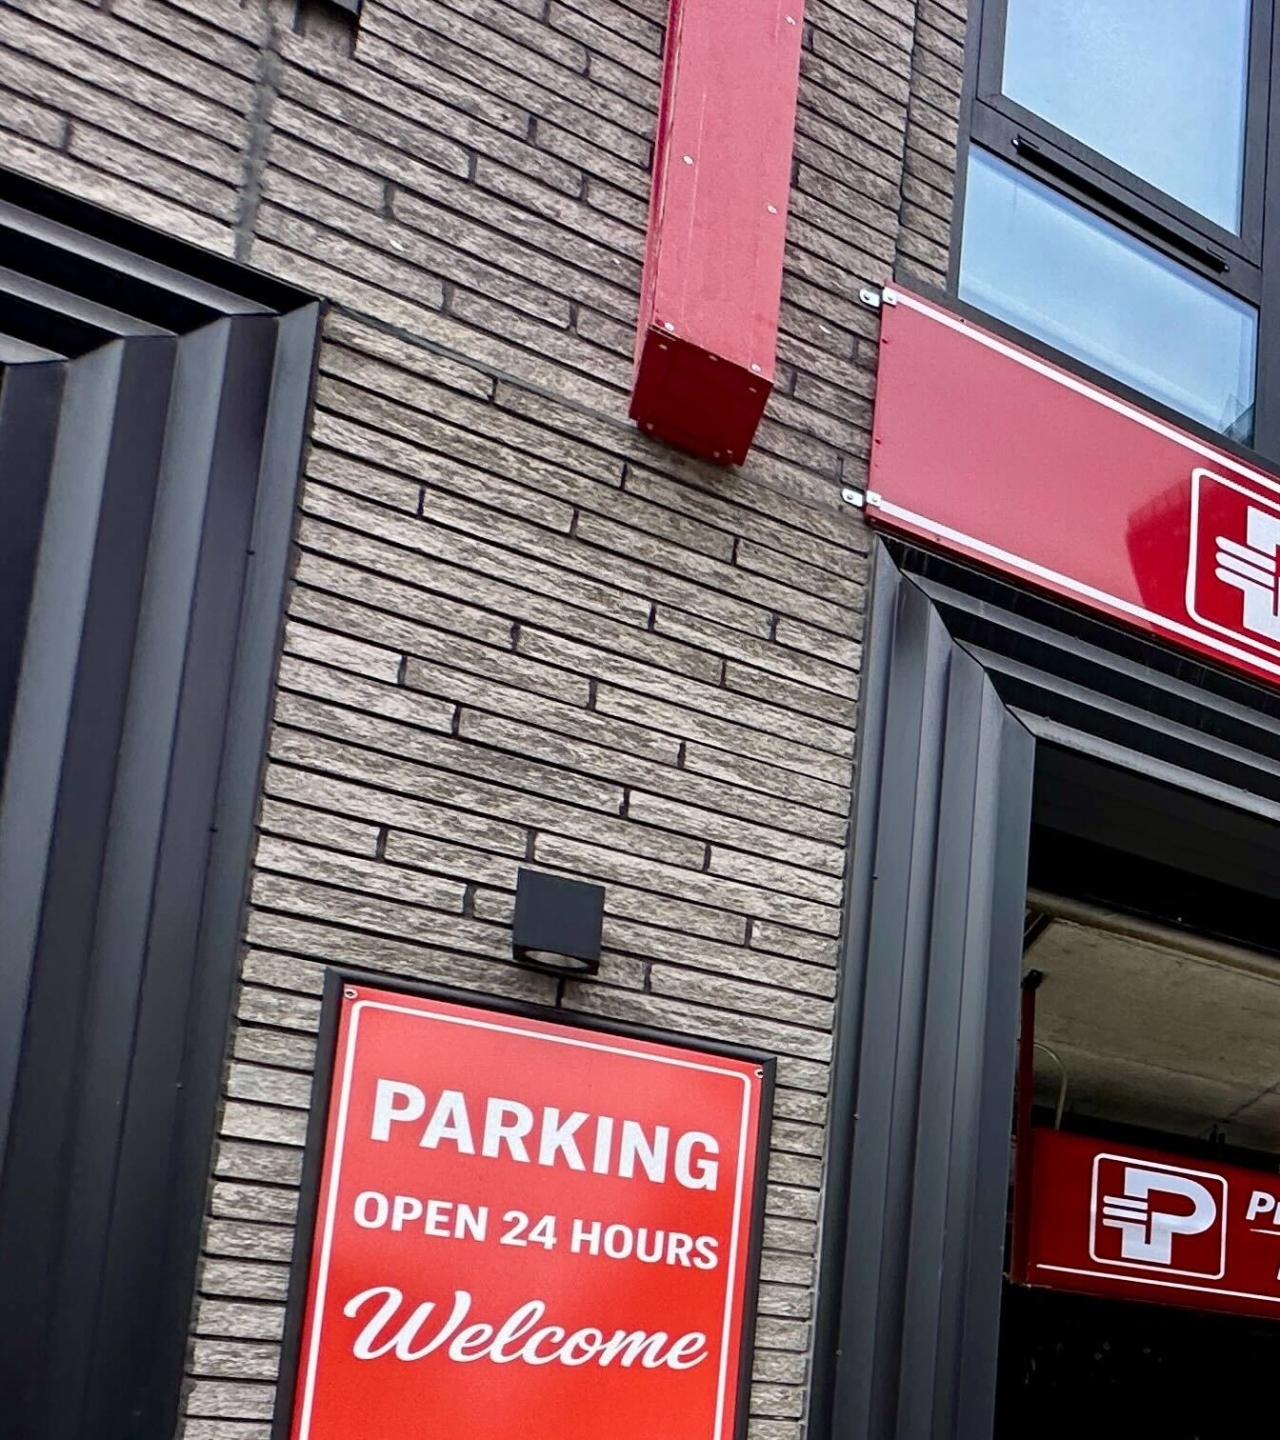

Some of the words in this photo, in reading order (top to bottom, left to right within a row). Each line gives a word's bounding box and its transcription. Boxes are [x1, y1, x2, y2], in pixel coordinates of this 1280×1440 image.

[370, 1077, 721, 1192] PARKING
[353, 1191, 487, 1242] OPEN
[500, 1210, 557, 1251] 24
[572, 1220, 720, 1270] HOURS
[343, 1285, 709, 1370] Welcome
